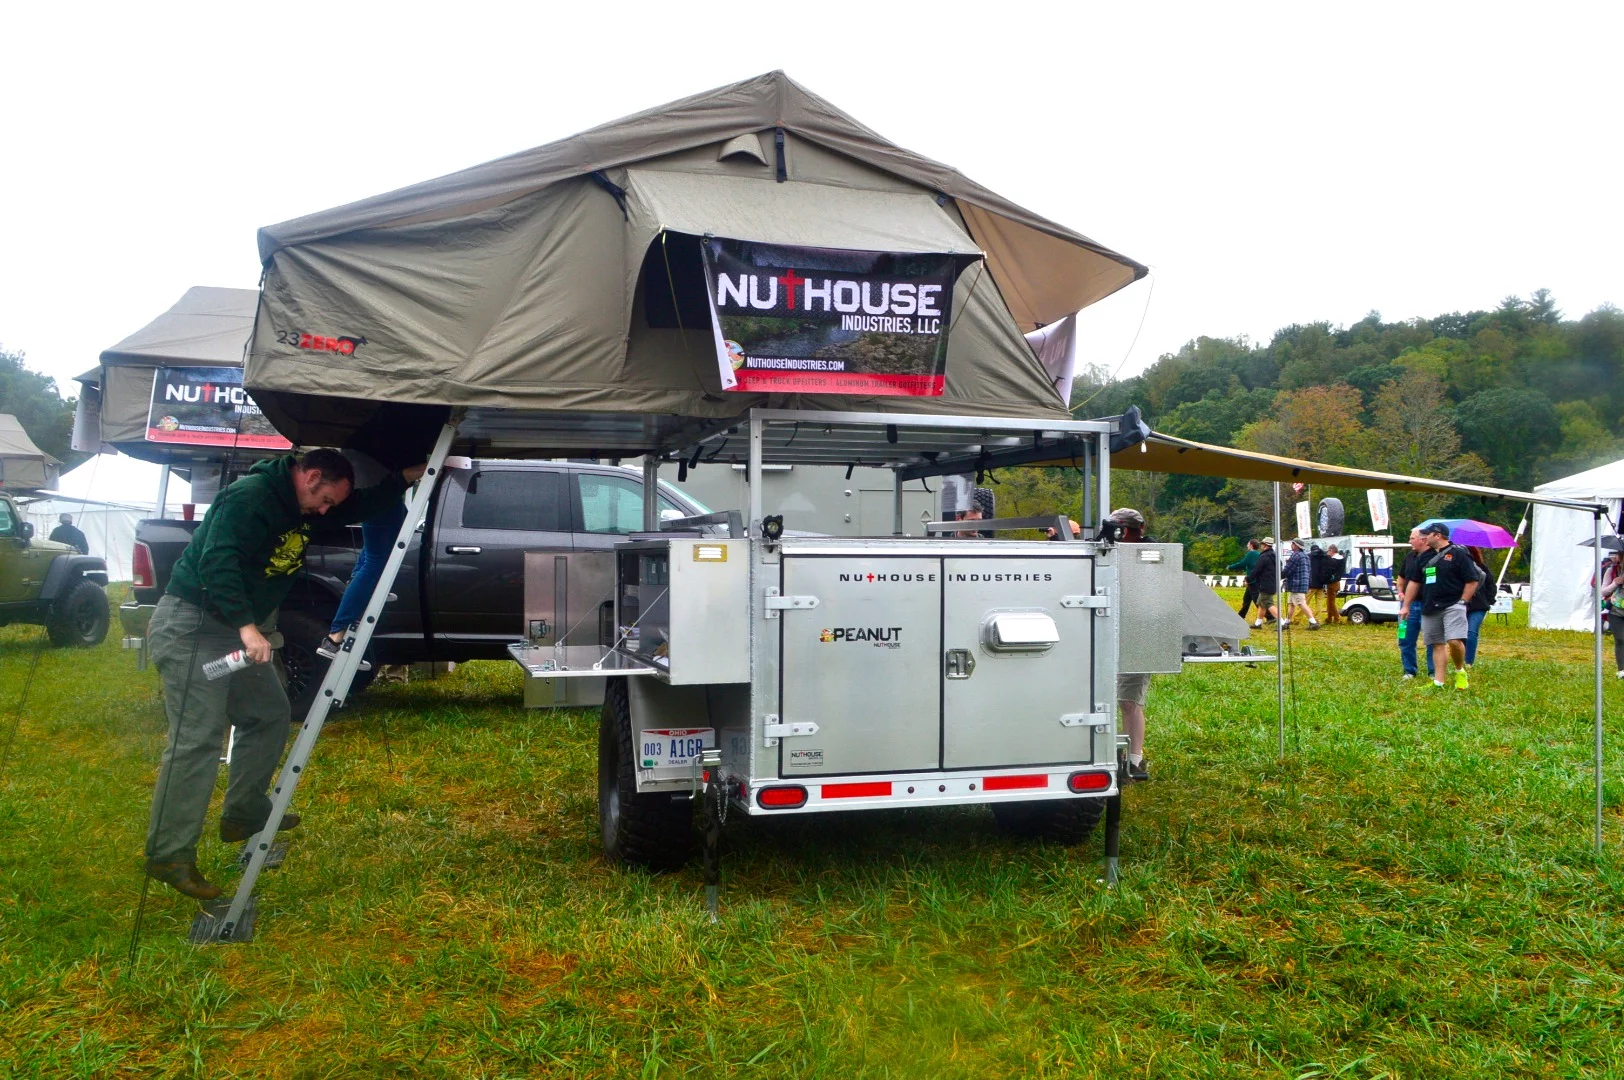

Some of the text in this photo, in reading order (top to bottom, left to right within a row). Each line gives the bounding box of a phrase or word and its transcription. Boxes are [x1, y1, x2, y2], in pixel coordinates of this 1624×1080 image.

[717, 269, 942, 316] NUTHOUSE
[841, 314, 940, 334] INDUSTRIES, LLC
[769, 377, 790, 386] TRUCK
[839, 572, 1053, 583] NUTHOUSE INDUSTRIES
[833, 627, 902, 642] PEANUT
[644, 742, 662, 756] 003
